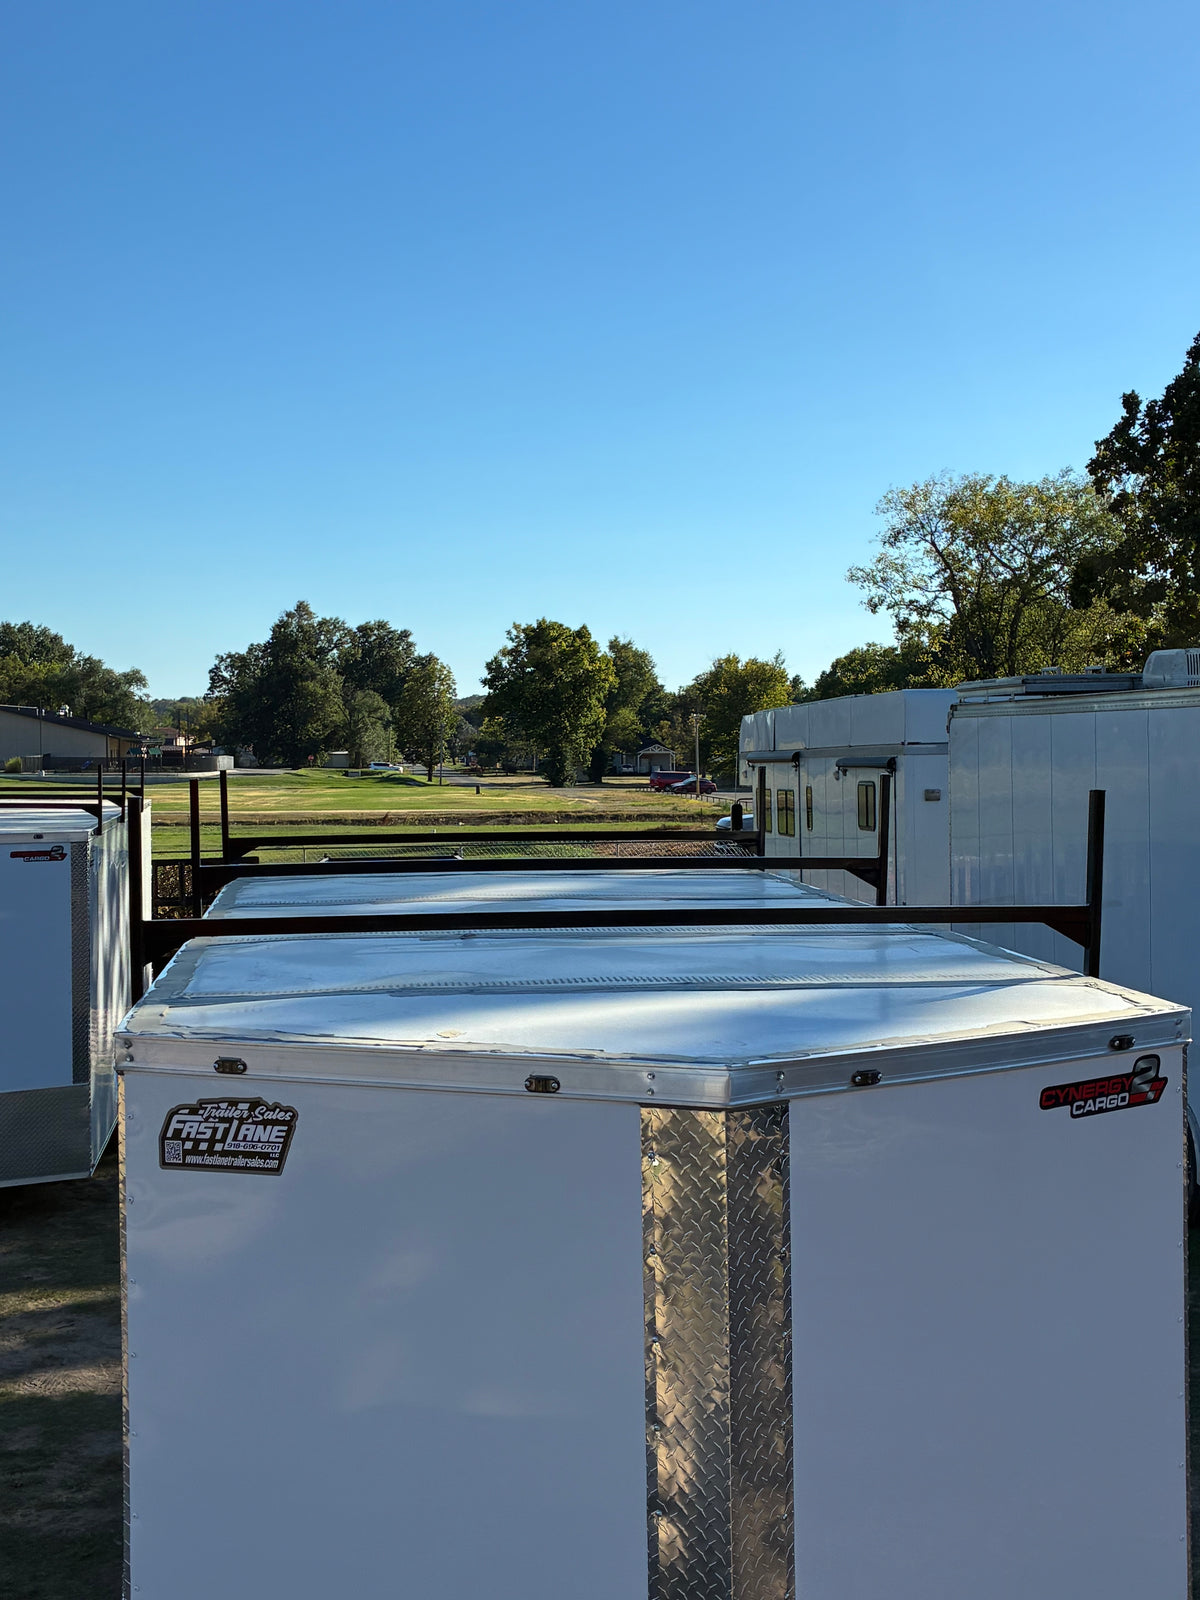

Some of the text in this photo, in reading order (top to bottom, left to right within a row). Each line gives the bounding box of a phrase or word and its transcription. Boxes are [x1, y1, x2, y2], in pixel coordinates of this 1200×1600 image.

[1041, 1076, 1134, 1107] CYNERGY
[201, 1104, 293, 1121] Trailer Sales
[1072, 1092, 1129, 1115] CARGO
[166, 1114, 288, 1143] FAST LANE
[226, 1142, 281, 1151] 918-696-0701
[185, 1154, 279, 1168] www.fastlanetrailersales.com
